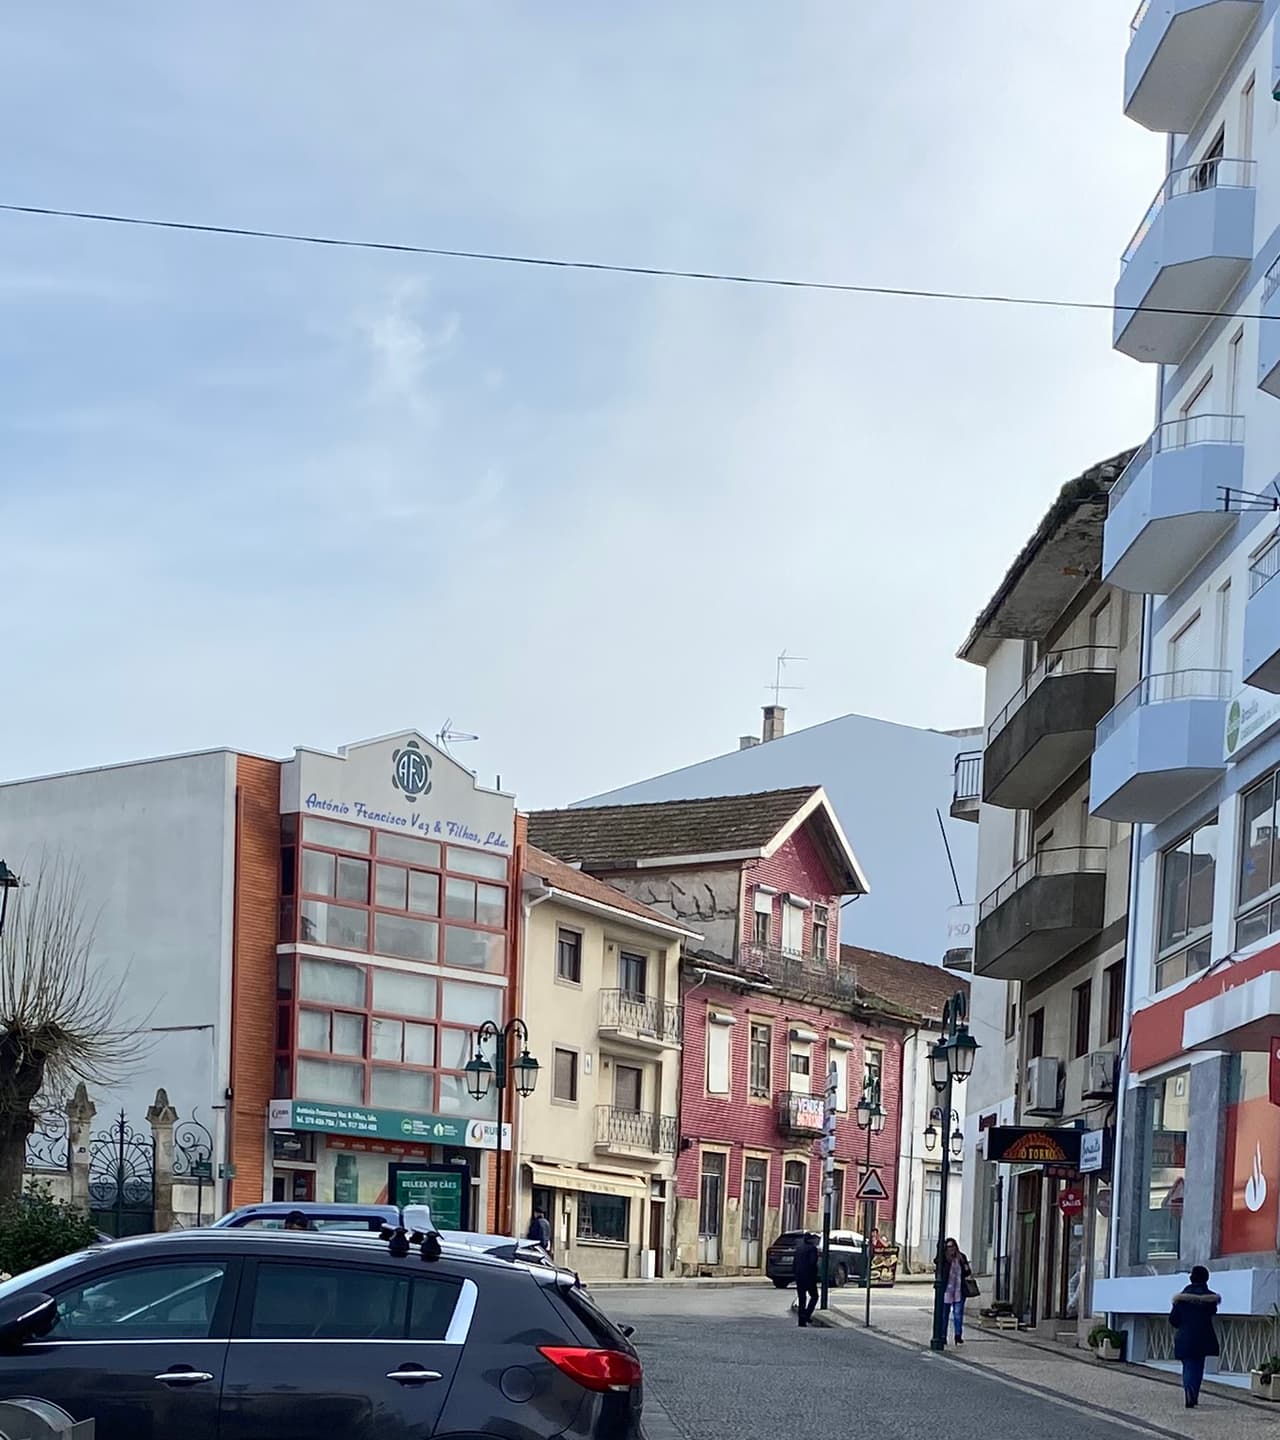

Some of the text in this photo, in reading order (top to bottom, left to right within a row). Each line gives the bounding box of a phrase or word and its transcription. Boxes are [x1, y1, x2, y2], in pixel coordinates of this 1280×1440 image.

[305, 793, 509, 849] António Francisco Vaz & Filhos, Lda.
[484, 1126, 507, 1136] RUS
